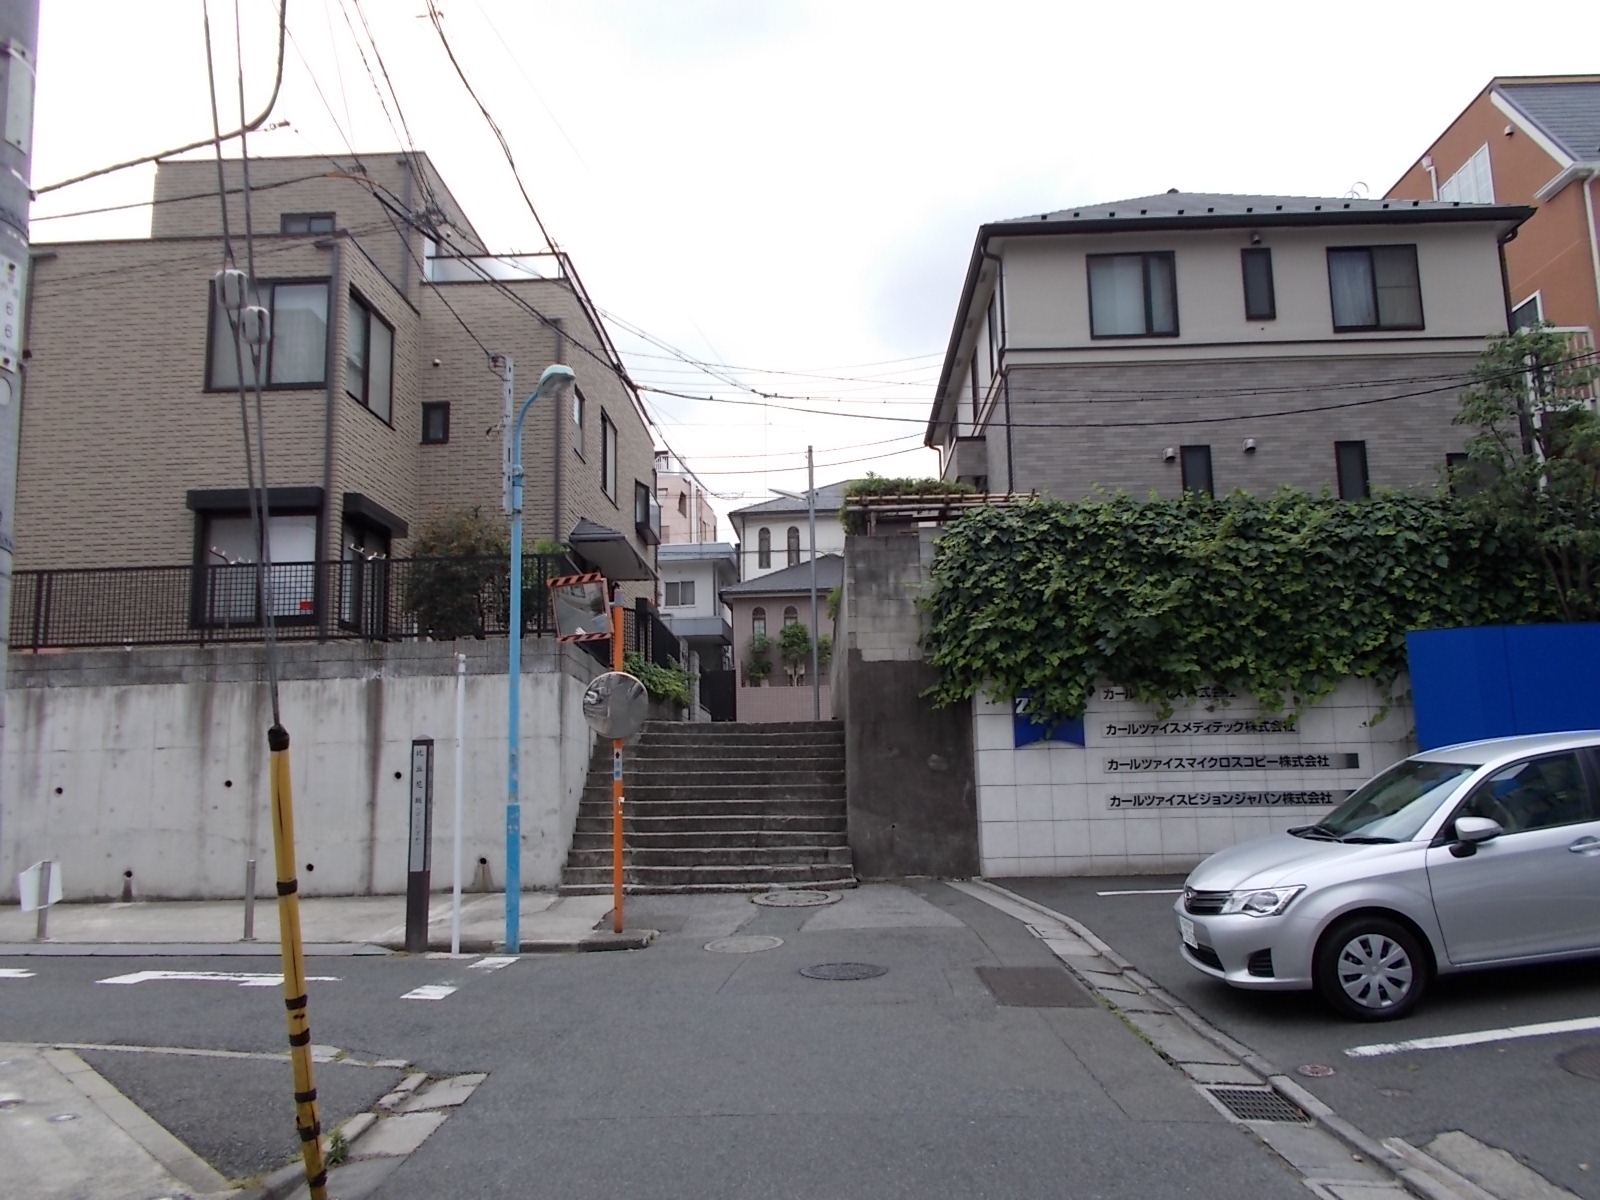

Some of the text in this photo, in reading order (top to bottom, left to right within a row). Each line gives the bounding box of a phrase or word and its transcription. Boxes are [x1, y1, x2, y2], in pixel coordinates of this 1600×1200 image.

[1106, 720, 1296, 736] カールツァイスメディテック株式会社
[1107, 754, 1331, 771] カールツァイスマイクロスコピー株式会社
[1109, 791, 1334, 808] カールツァイスビジョンジャパン株式会社
